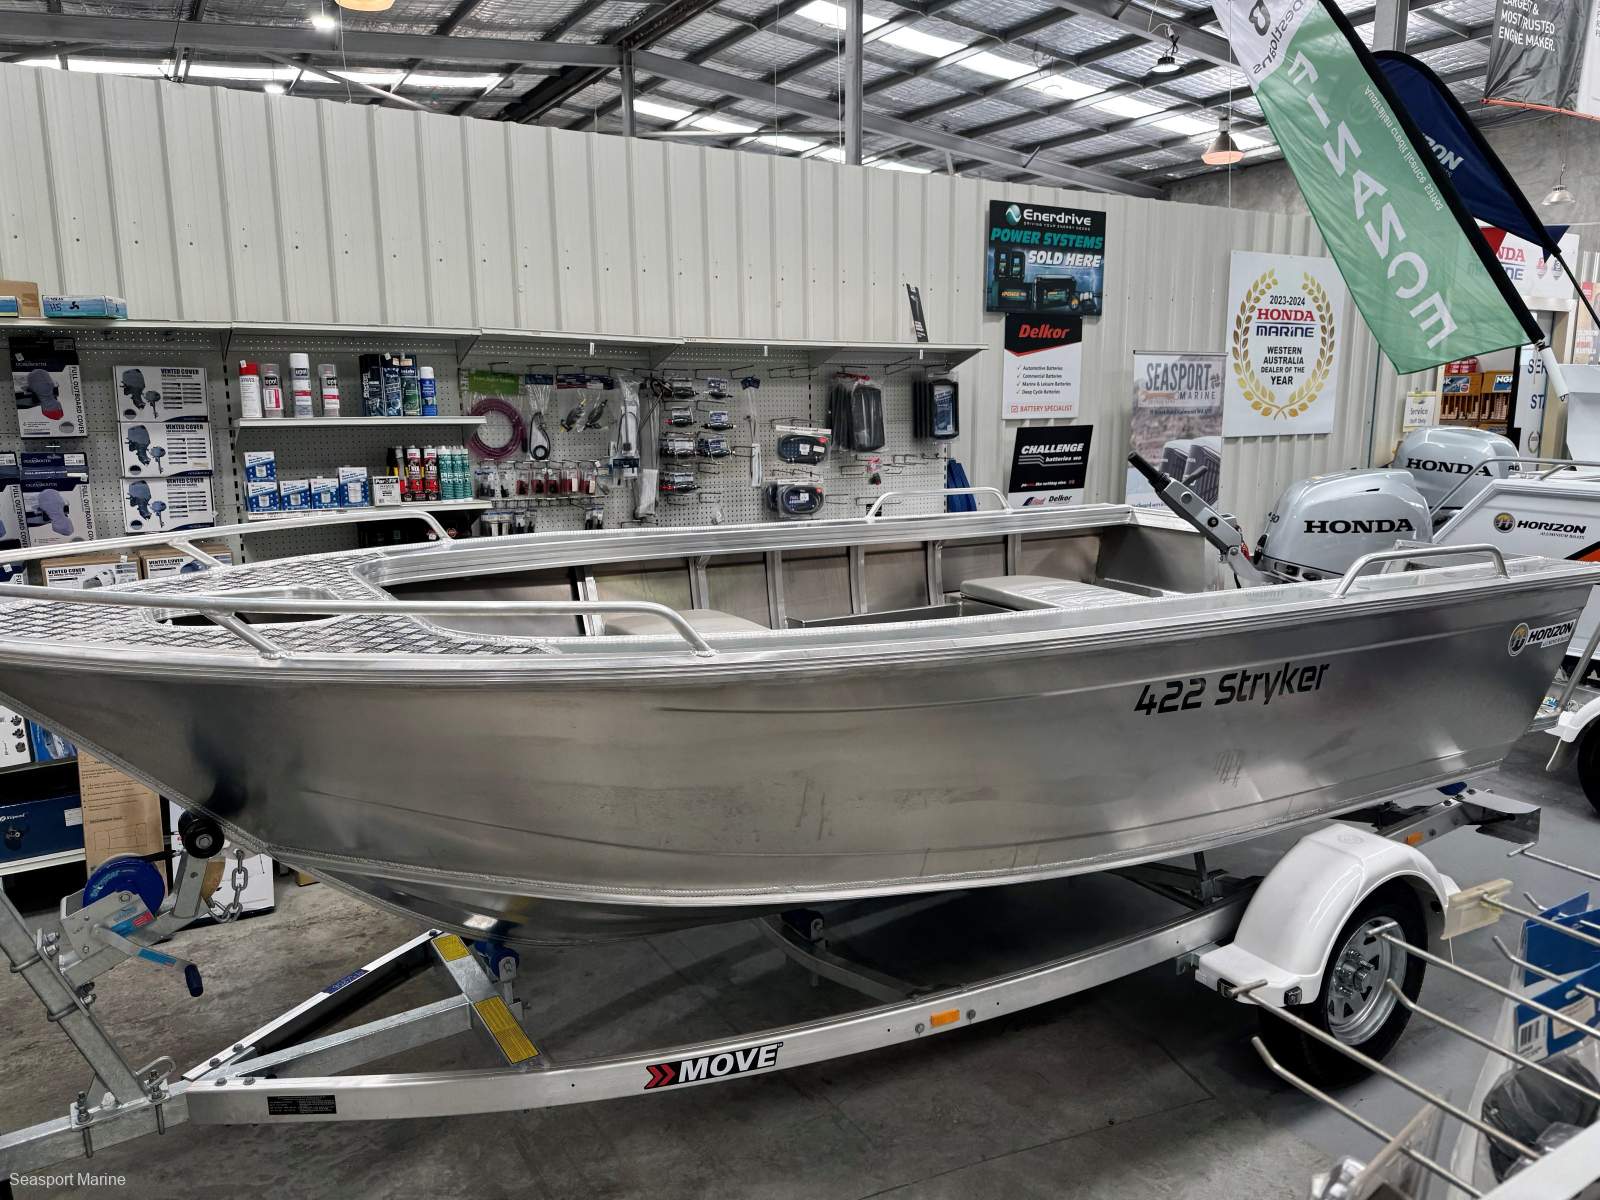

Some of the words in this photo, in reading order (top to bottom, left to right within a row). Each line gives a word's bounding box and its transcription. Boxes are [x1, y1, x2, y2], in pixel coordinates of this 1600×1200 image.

[1023, 208, 1092, 226] Enerdrive
[991, 227, 1041, 244] POWER
[1043, 232, 1104, 249] SYSTEMS
[1027, 250, 1063, 265] SOLD
[1065, 253, 1102, 267] HERE
[1269, 295, 1306, 306] 2023-2024
[1256, 308, 1316, 322] HONDA
[1018, 324, 1071, 339] Delkor
[1267, 346, 1303, 355] WESTERN
[1263, 356, 1304, 365] AUSTRALIA
[71, 366, 79, 380] FULL
[1146, 362, 1213, 391] SEASPORT
[1271, 376, 1294, 385] YEAR
[73, 380, 82, 414] OUTBOARD
[1179, 391, 1216, 400] MARINE
[1044, 404, 1072, 412] SPECIALIST
[76, 414, 85, 434] COVER
[1021, 443, 1085, 454] CHALLENGE
[1406, 457, 1494, 477] HONDA
[12, 485, 20, 499] FULL
[83, 499, 92, 530] OUTBOARD
[1303, 518, 1415, 534] HONDA
[1517, 520, 1587, 534] HORIZON
[47, 568, 68, 576] VENTED
[69, 567, 86, 575] COVER
[1527, 621, 1574, 643] HORIZON
[1133, 677, 1207, 716] 422
[1214, 662, 1331, 705] Stryker
[678, 1043, 779, 1083] MOVE
